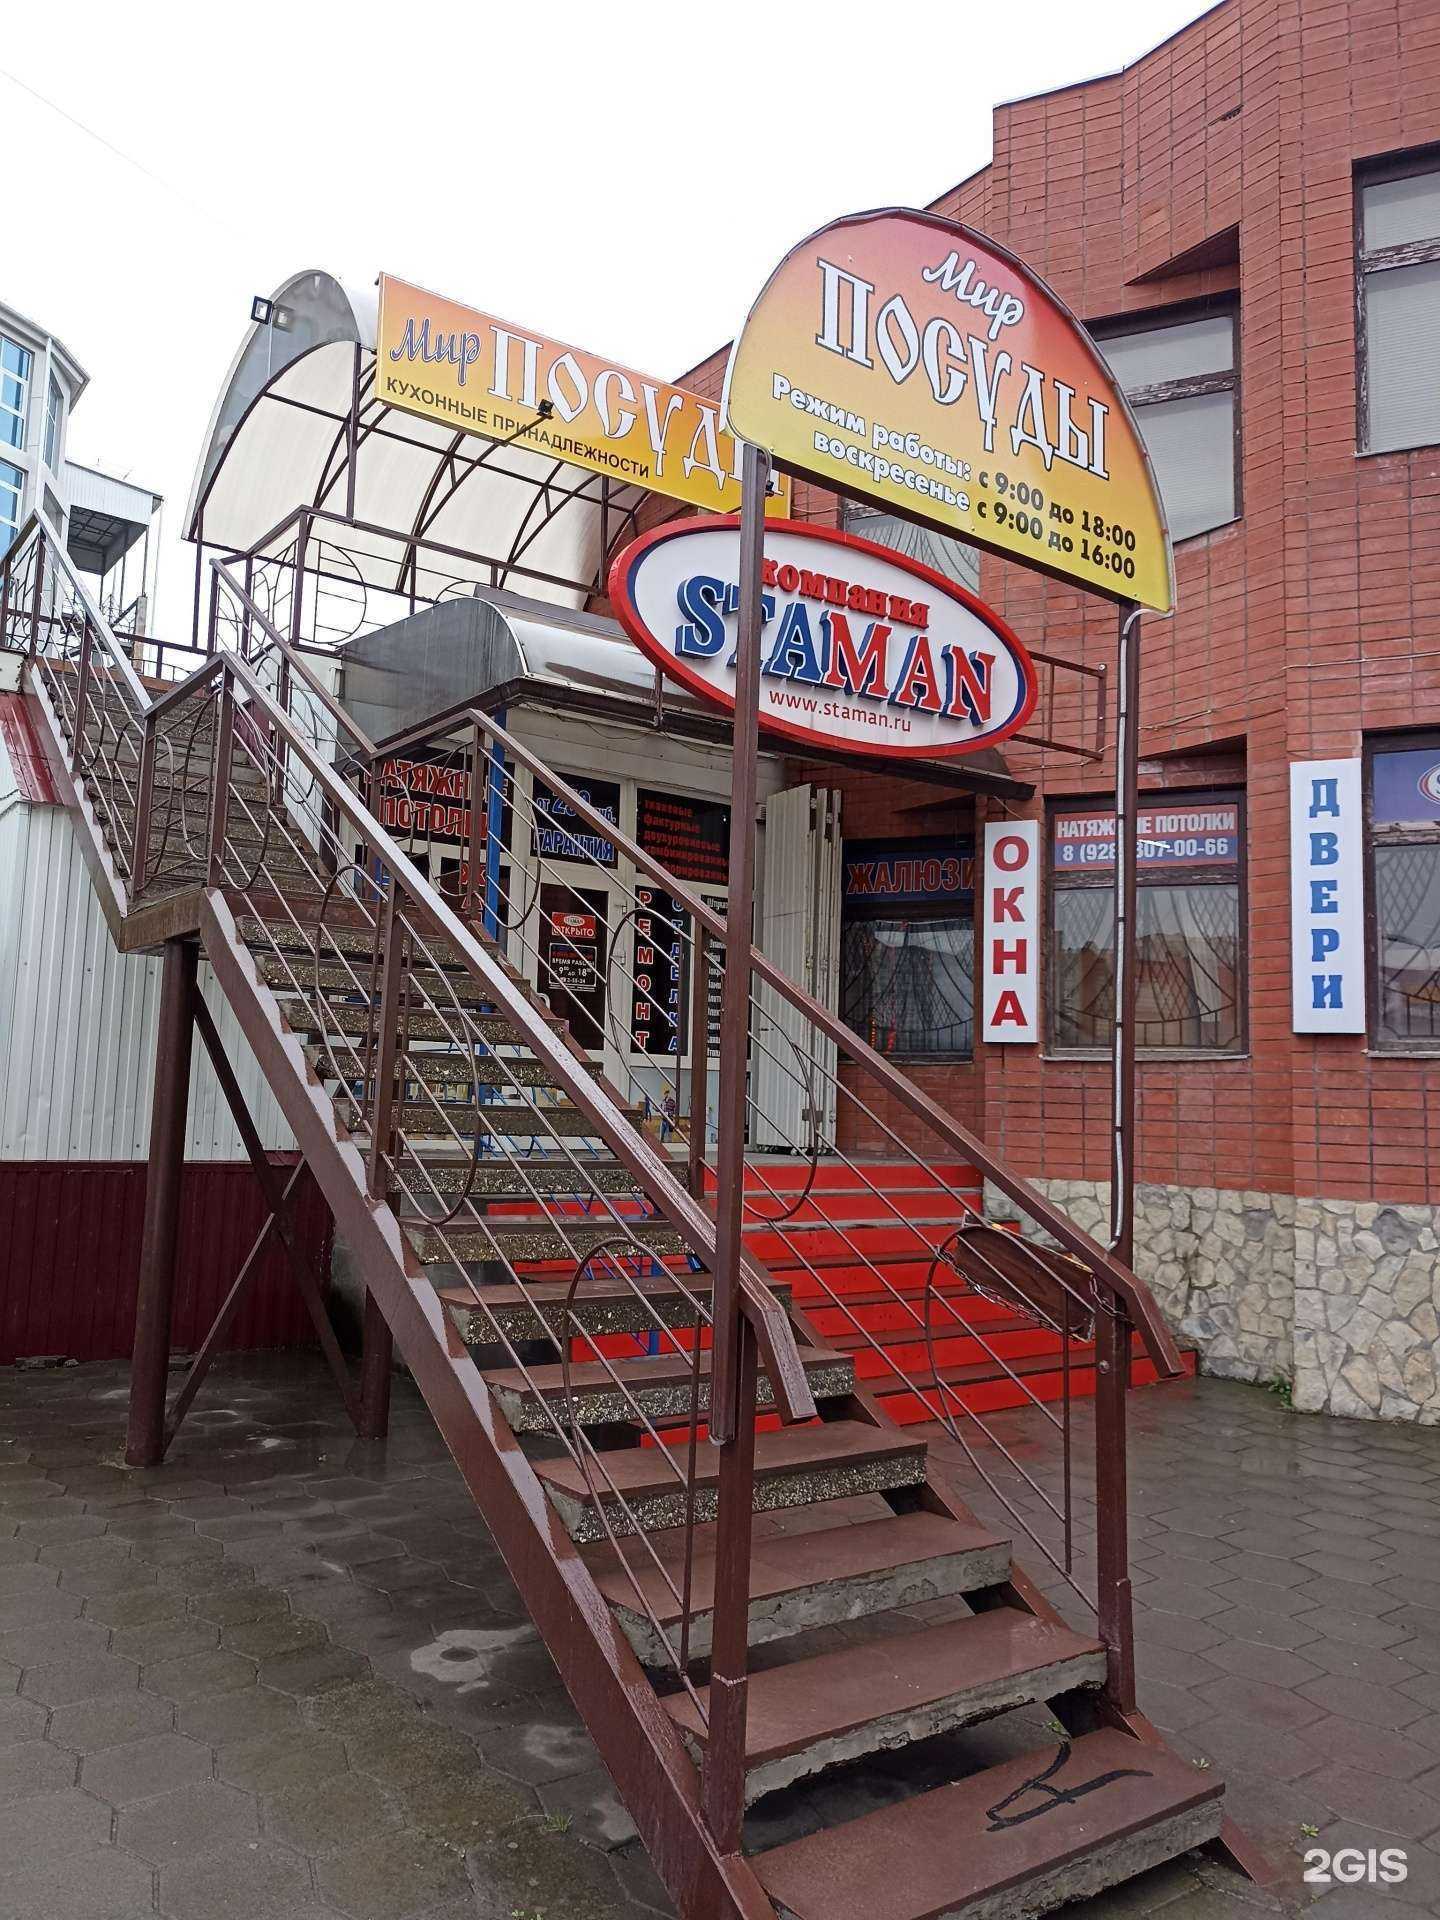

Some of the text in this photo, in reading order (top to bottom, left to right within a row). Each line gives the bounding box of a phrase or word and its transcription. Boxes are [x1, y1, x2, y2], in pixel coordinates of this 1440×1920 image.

[922, 250, 1024, 340] Мир
[390, 317, 481, 386] Мир
[815, 256, 1110, 480] ПОСУДЫ
[386, 376, 650, 479] КУХОННЫЕ ПРИНАДЛЕЖНОСТИ
[772, 373, 1136, 552] Режим работы: с 9:00 до 18:00
[813, 430, 1136, 580] воскресенье с 9:00 до 16:00
[761, 558, 930, 629] компания
[769, 689, 911, 733] www.staman.ru
[533, 827, 615, 861] ГАРАНТИЯ
[1057, 811, 1235, 838] НАТЯЖЕ ПОТОЛКИ
[1062, 846, 1074, 861] 8
[847, 857, 976, 895] ЖАЛЮЗИ
[1308, 778, 1343, 1009] ДВЕРИ
[554, 926, 594, 936] ОТКРЫТО
[635, 890, 654, 1049] РЕМОНТ
[991, 835, 1030, 1027] ОКНА
